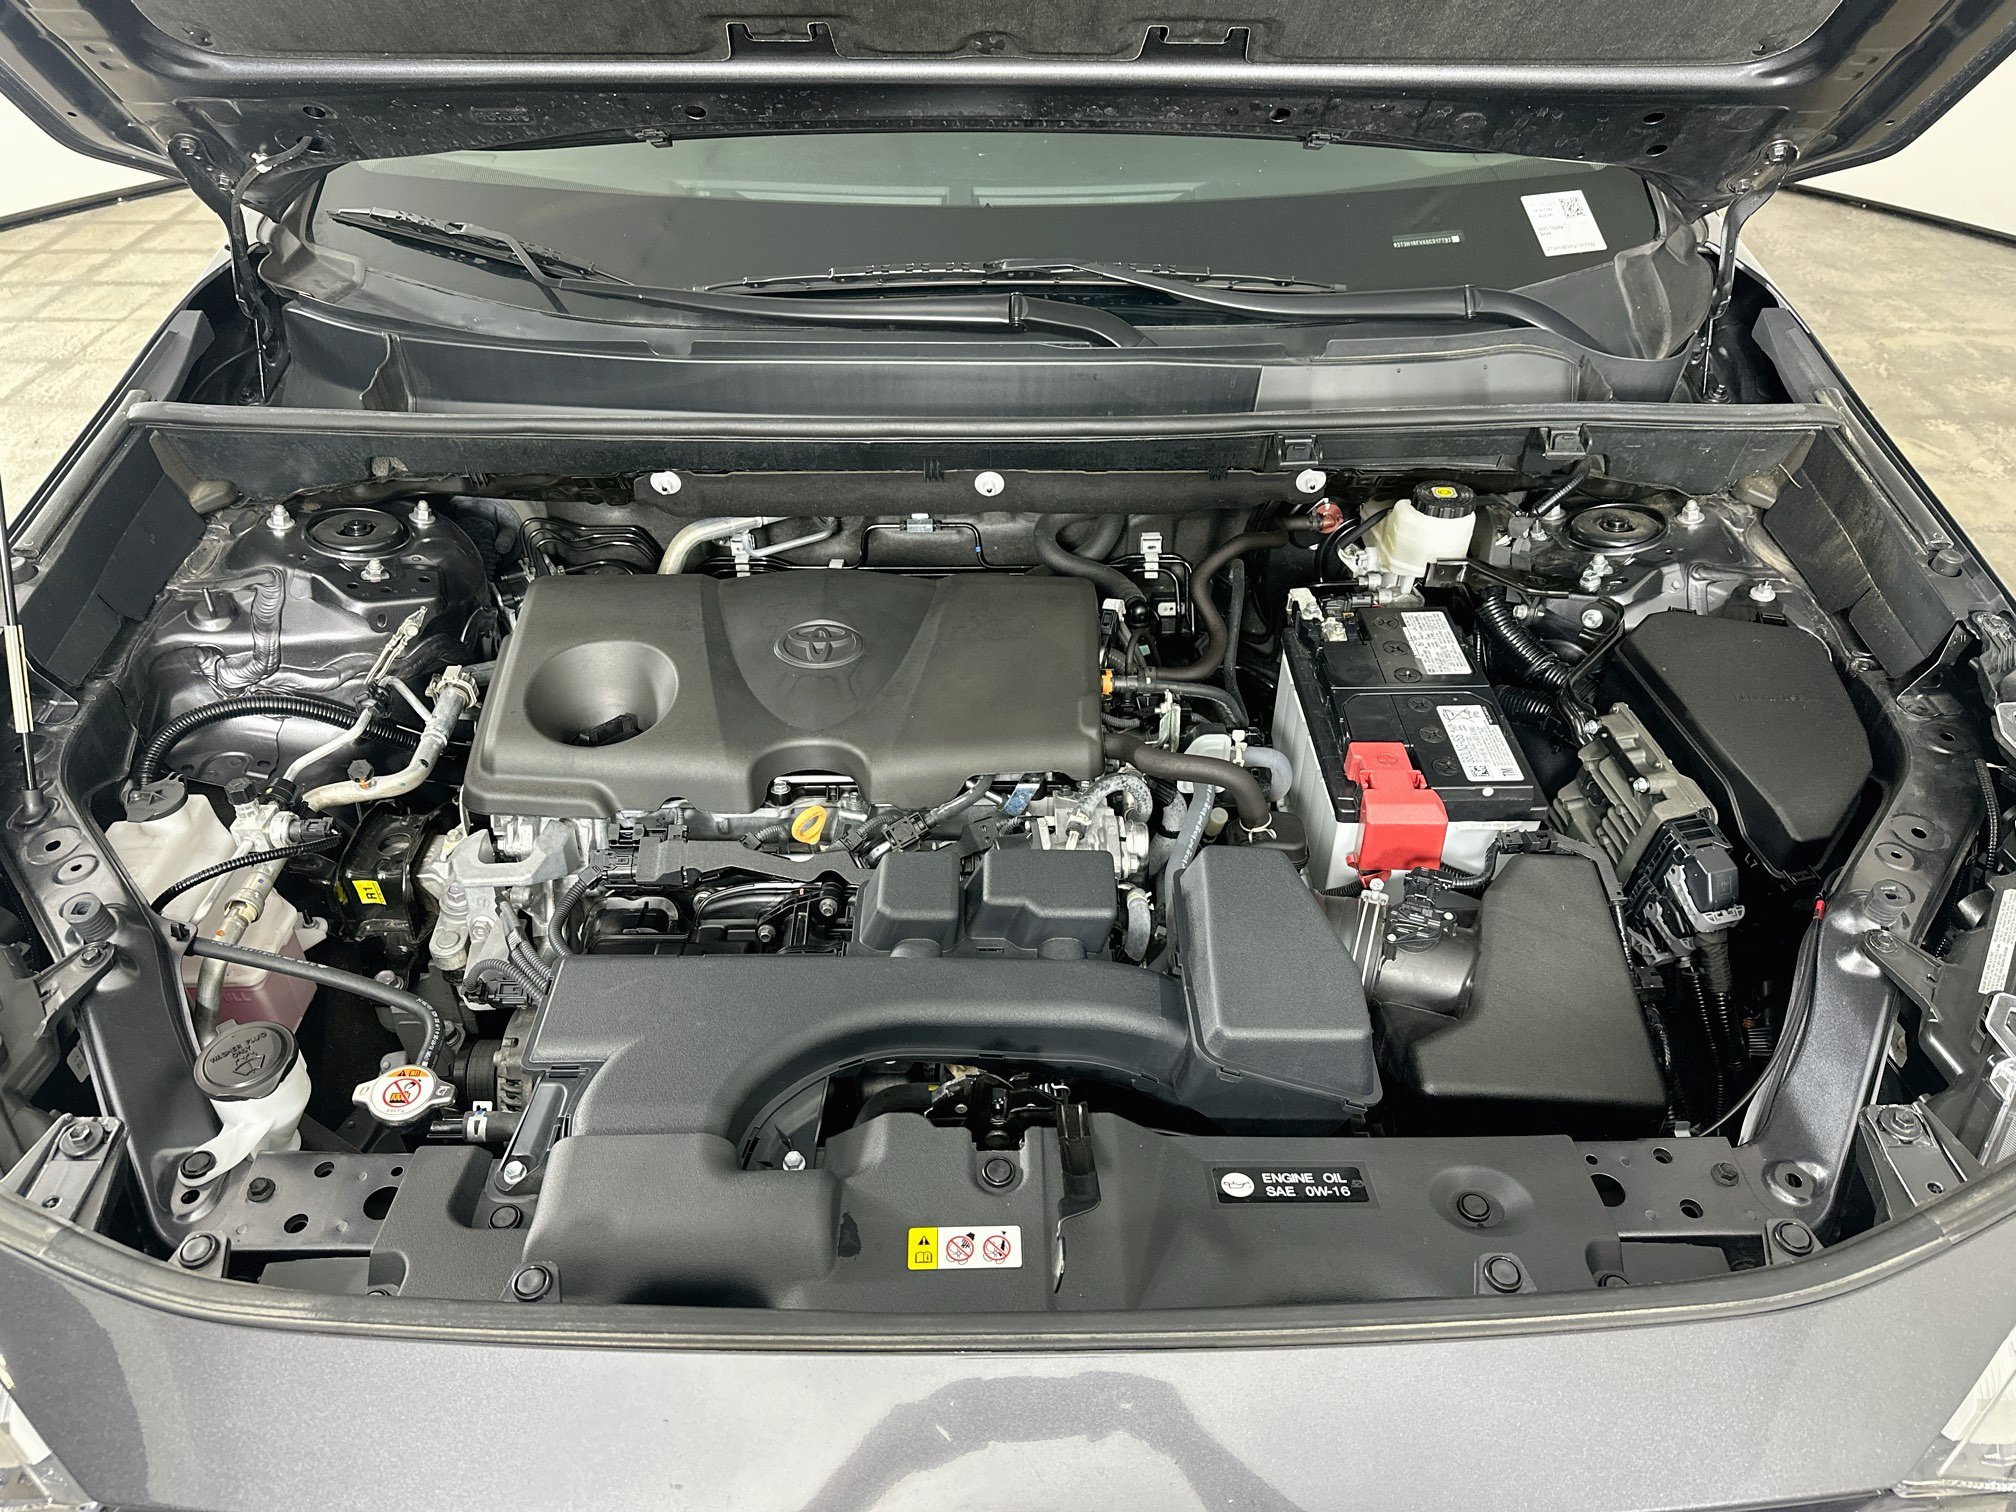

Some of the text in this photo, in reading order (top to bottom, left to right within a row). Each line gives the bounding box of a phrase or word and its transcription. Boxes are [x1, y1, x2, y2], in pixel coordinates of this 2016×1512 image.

[363, 887, 377, 899] R1
[209, 1032, 268, 1064] WASHER FLUID
[232, 1045, 251, 1059] ONLY
[1261, 1172, 1315, 1184] ENGINE
[1322, 1172, 1348, 1184] OIL
[1265, 1186, 1351, 1198] SAE 0W-16
